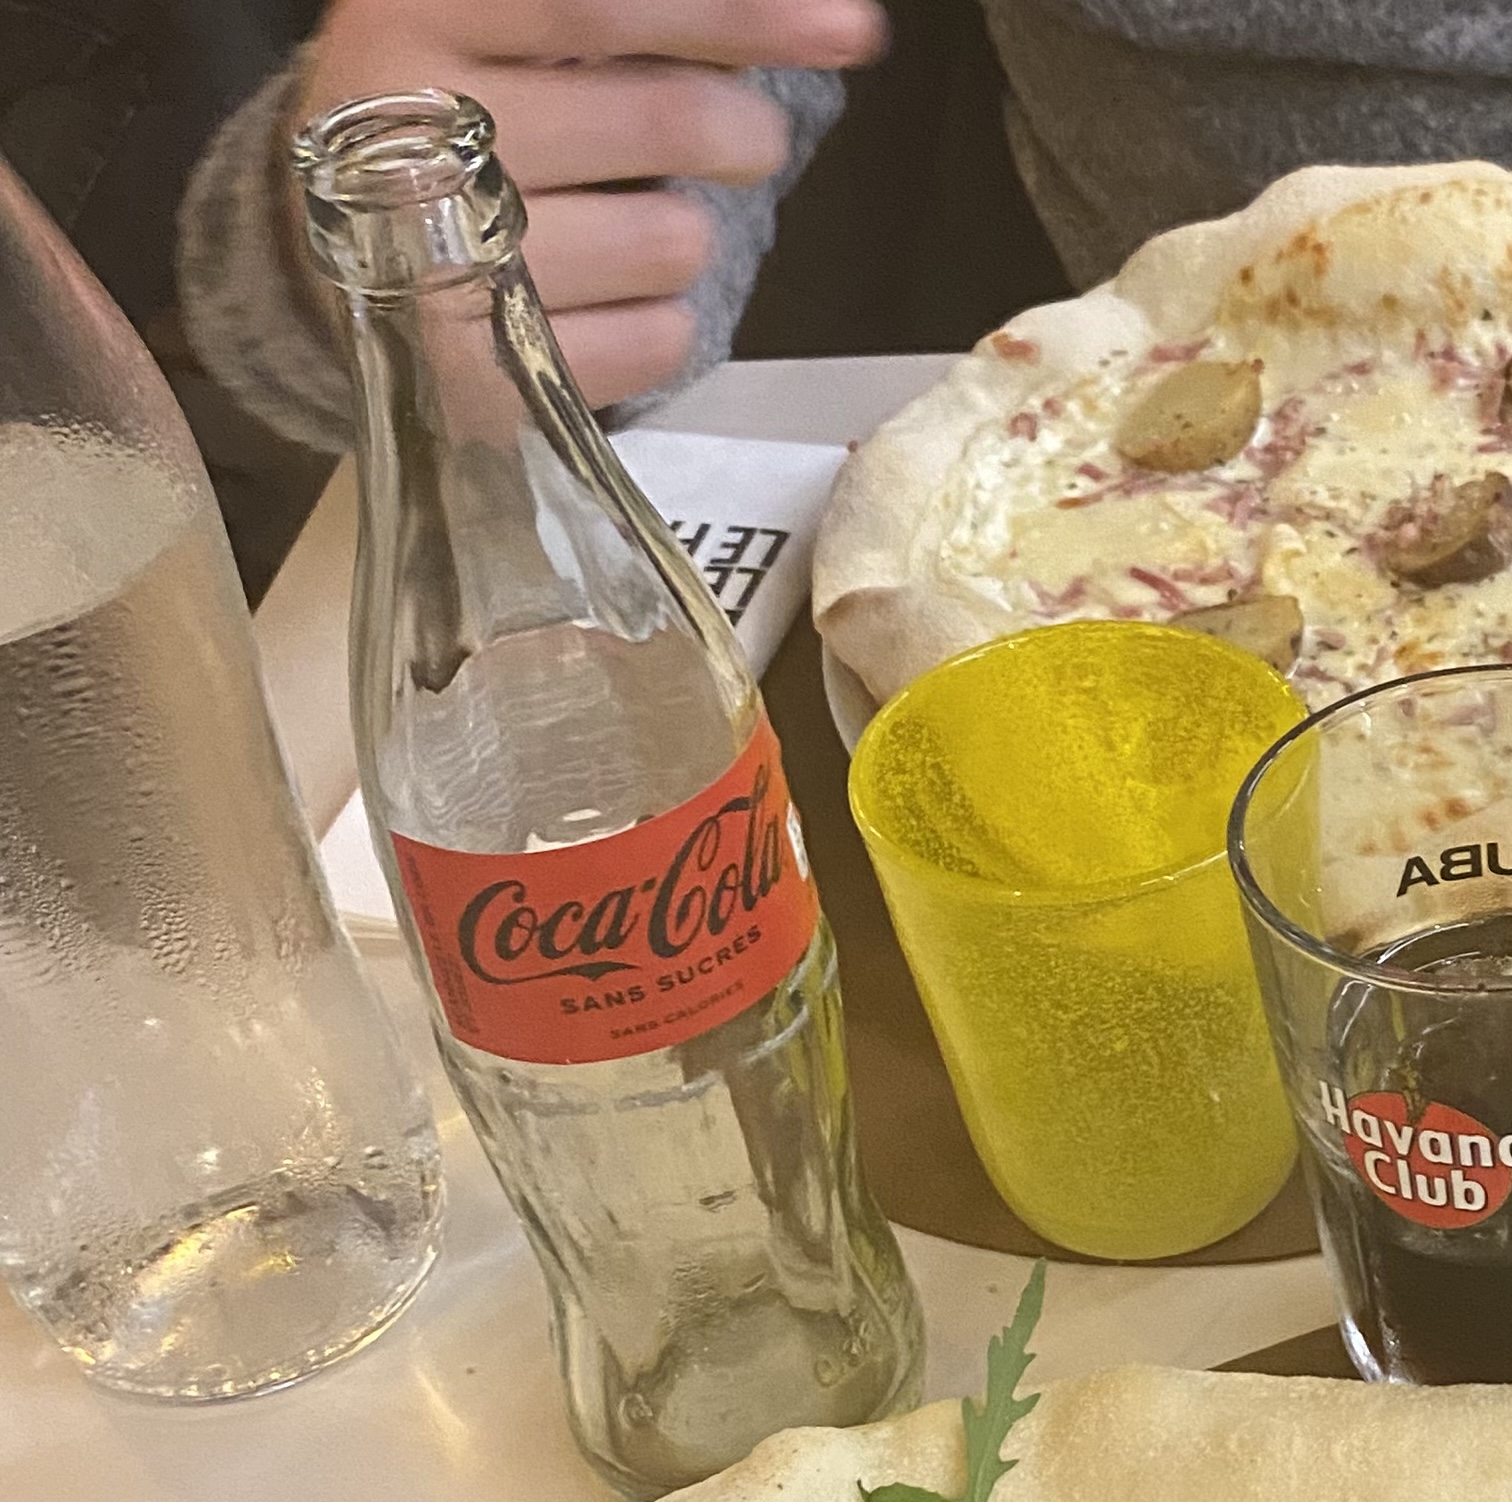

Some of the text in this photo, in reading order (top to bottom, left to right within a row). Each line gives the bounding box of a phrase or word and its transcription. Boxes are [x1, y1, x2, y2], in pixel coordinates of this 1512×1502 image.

[457, 764, 784, 985] Coca-Cola
[560, 924, 762, 1015] SANS SUCRES
[1363, 1150, 1487, 1213] Club
